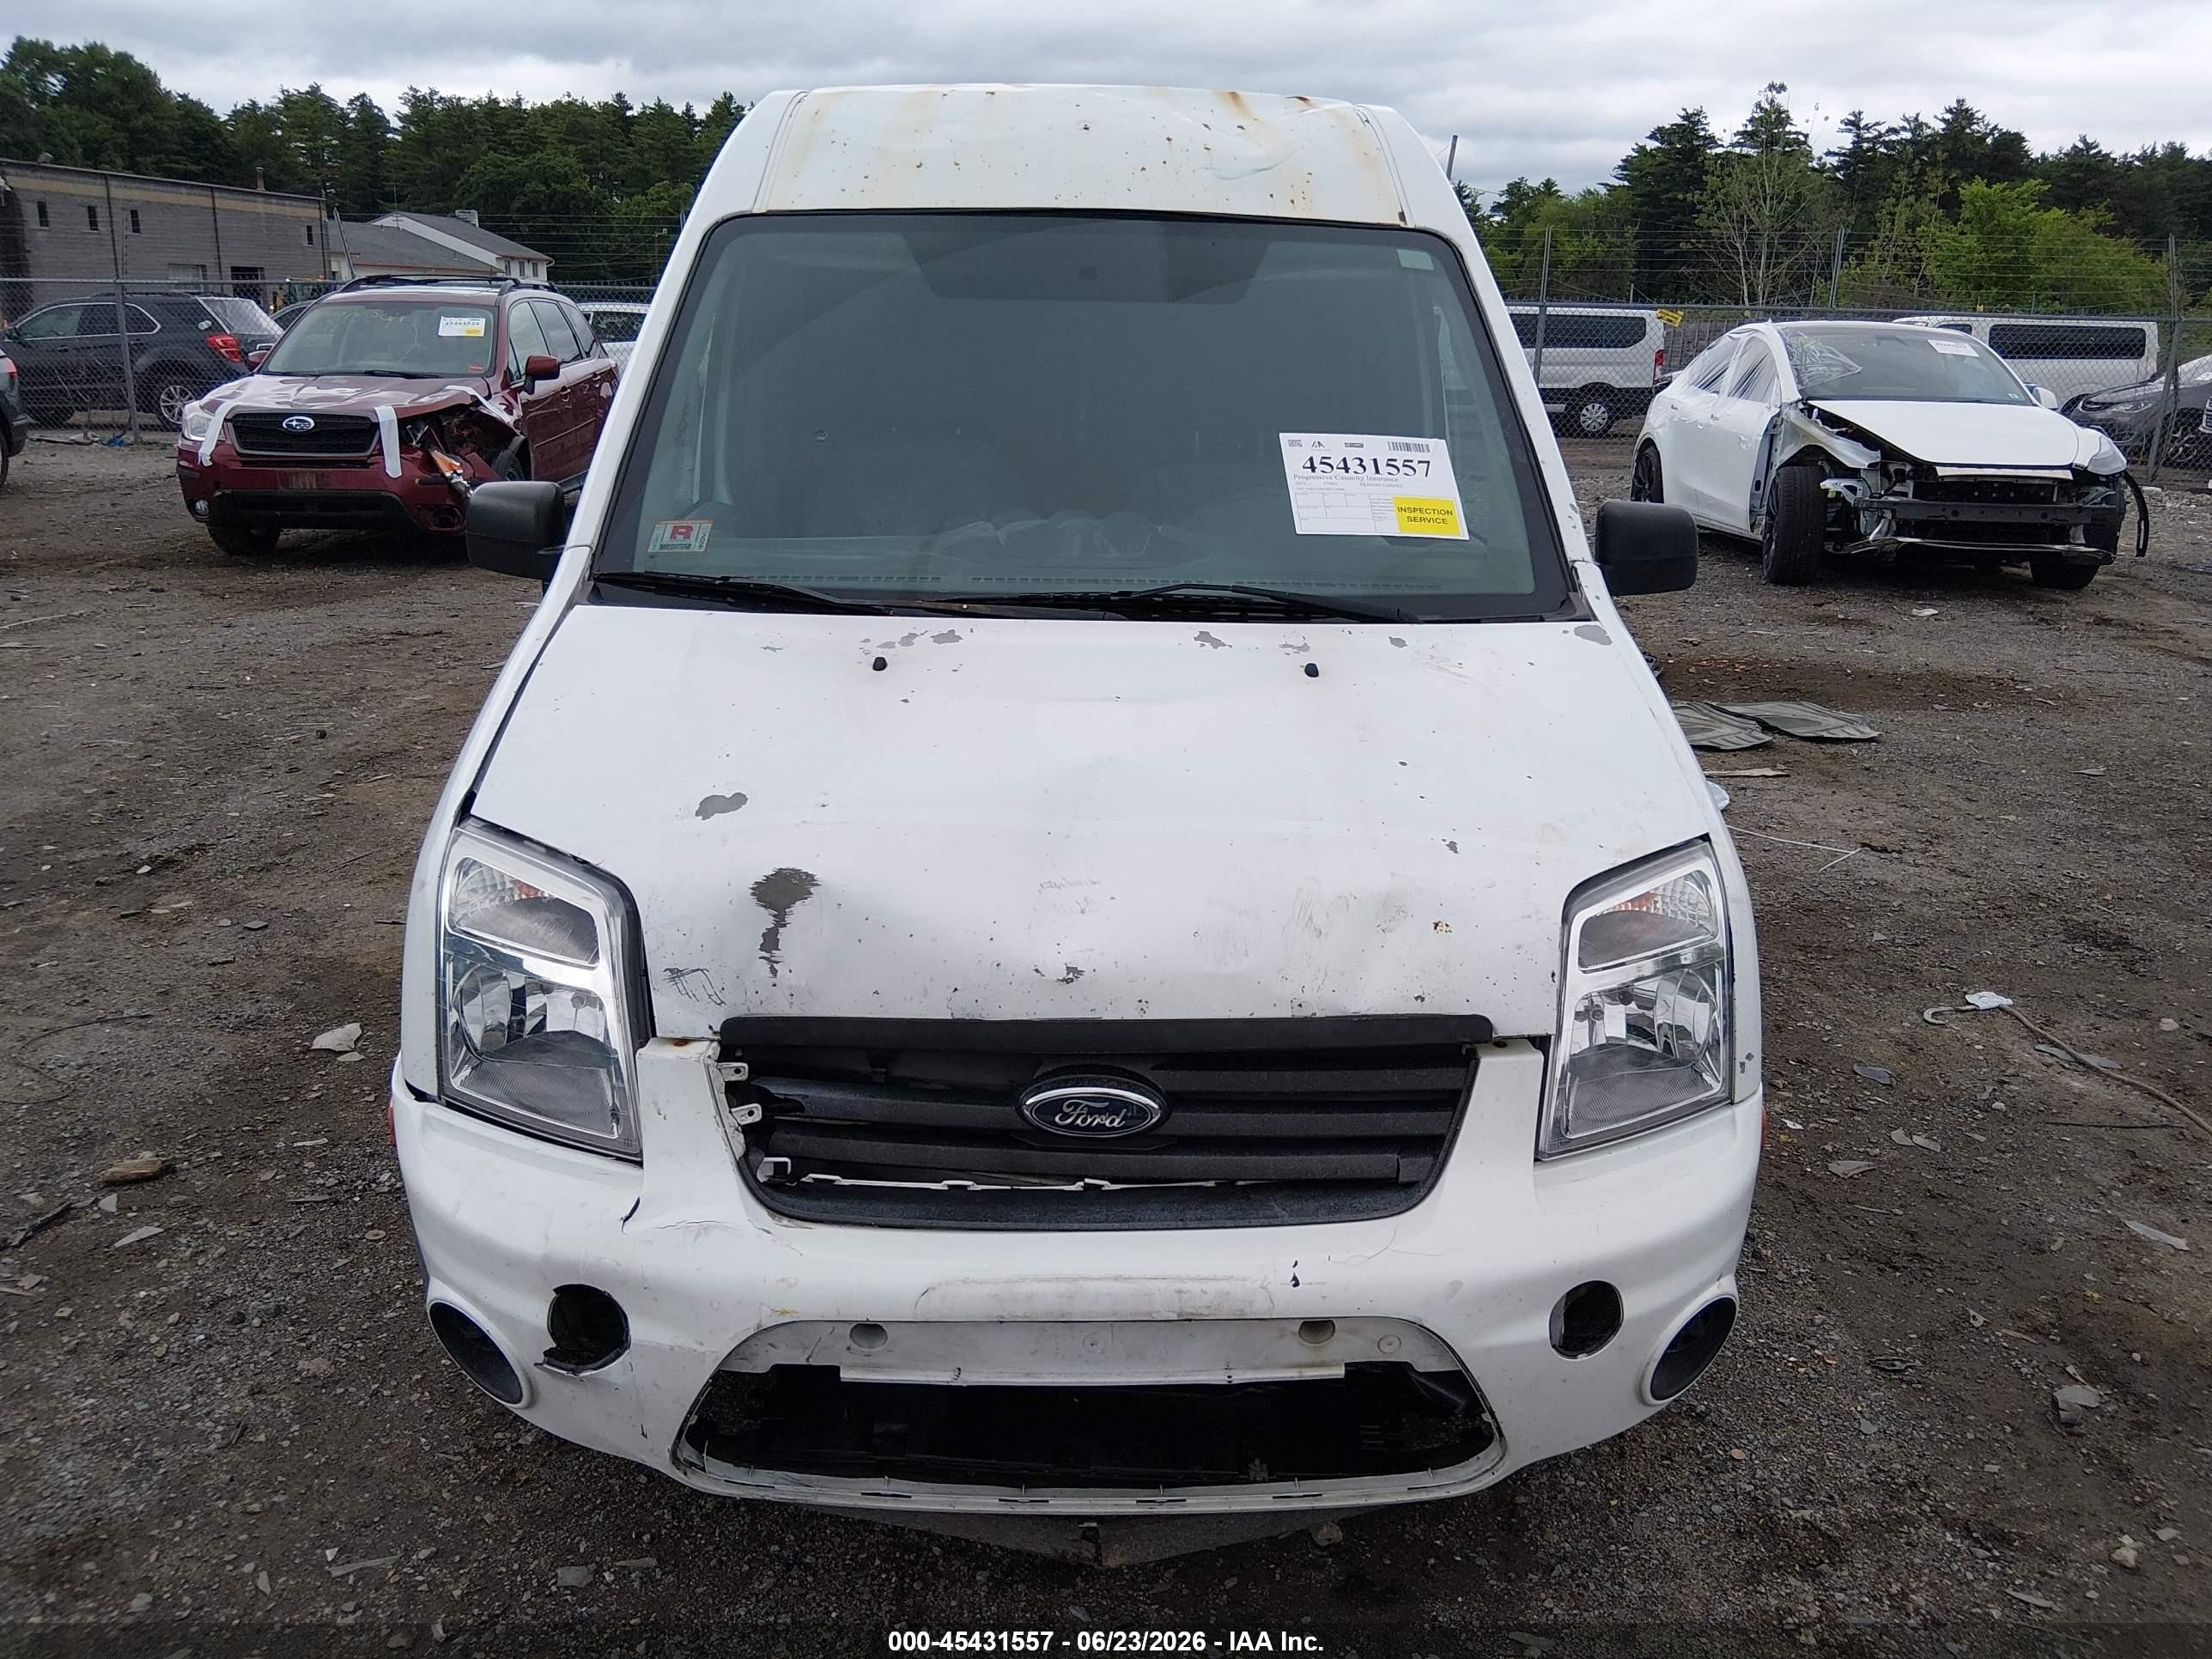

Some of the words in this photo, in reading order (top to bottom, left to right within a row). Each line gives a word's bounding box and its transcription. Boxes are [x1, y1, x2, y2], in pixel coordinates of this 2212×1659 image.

[1302, 455, 1431, 477] 45431557
[1397, 507, 1453, 515] INSPECTION
[670, 525, 693, 540] R
[1054, 1099, 1127, 1127] Ford
